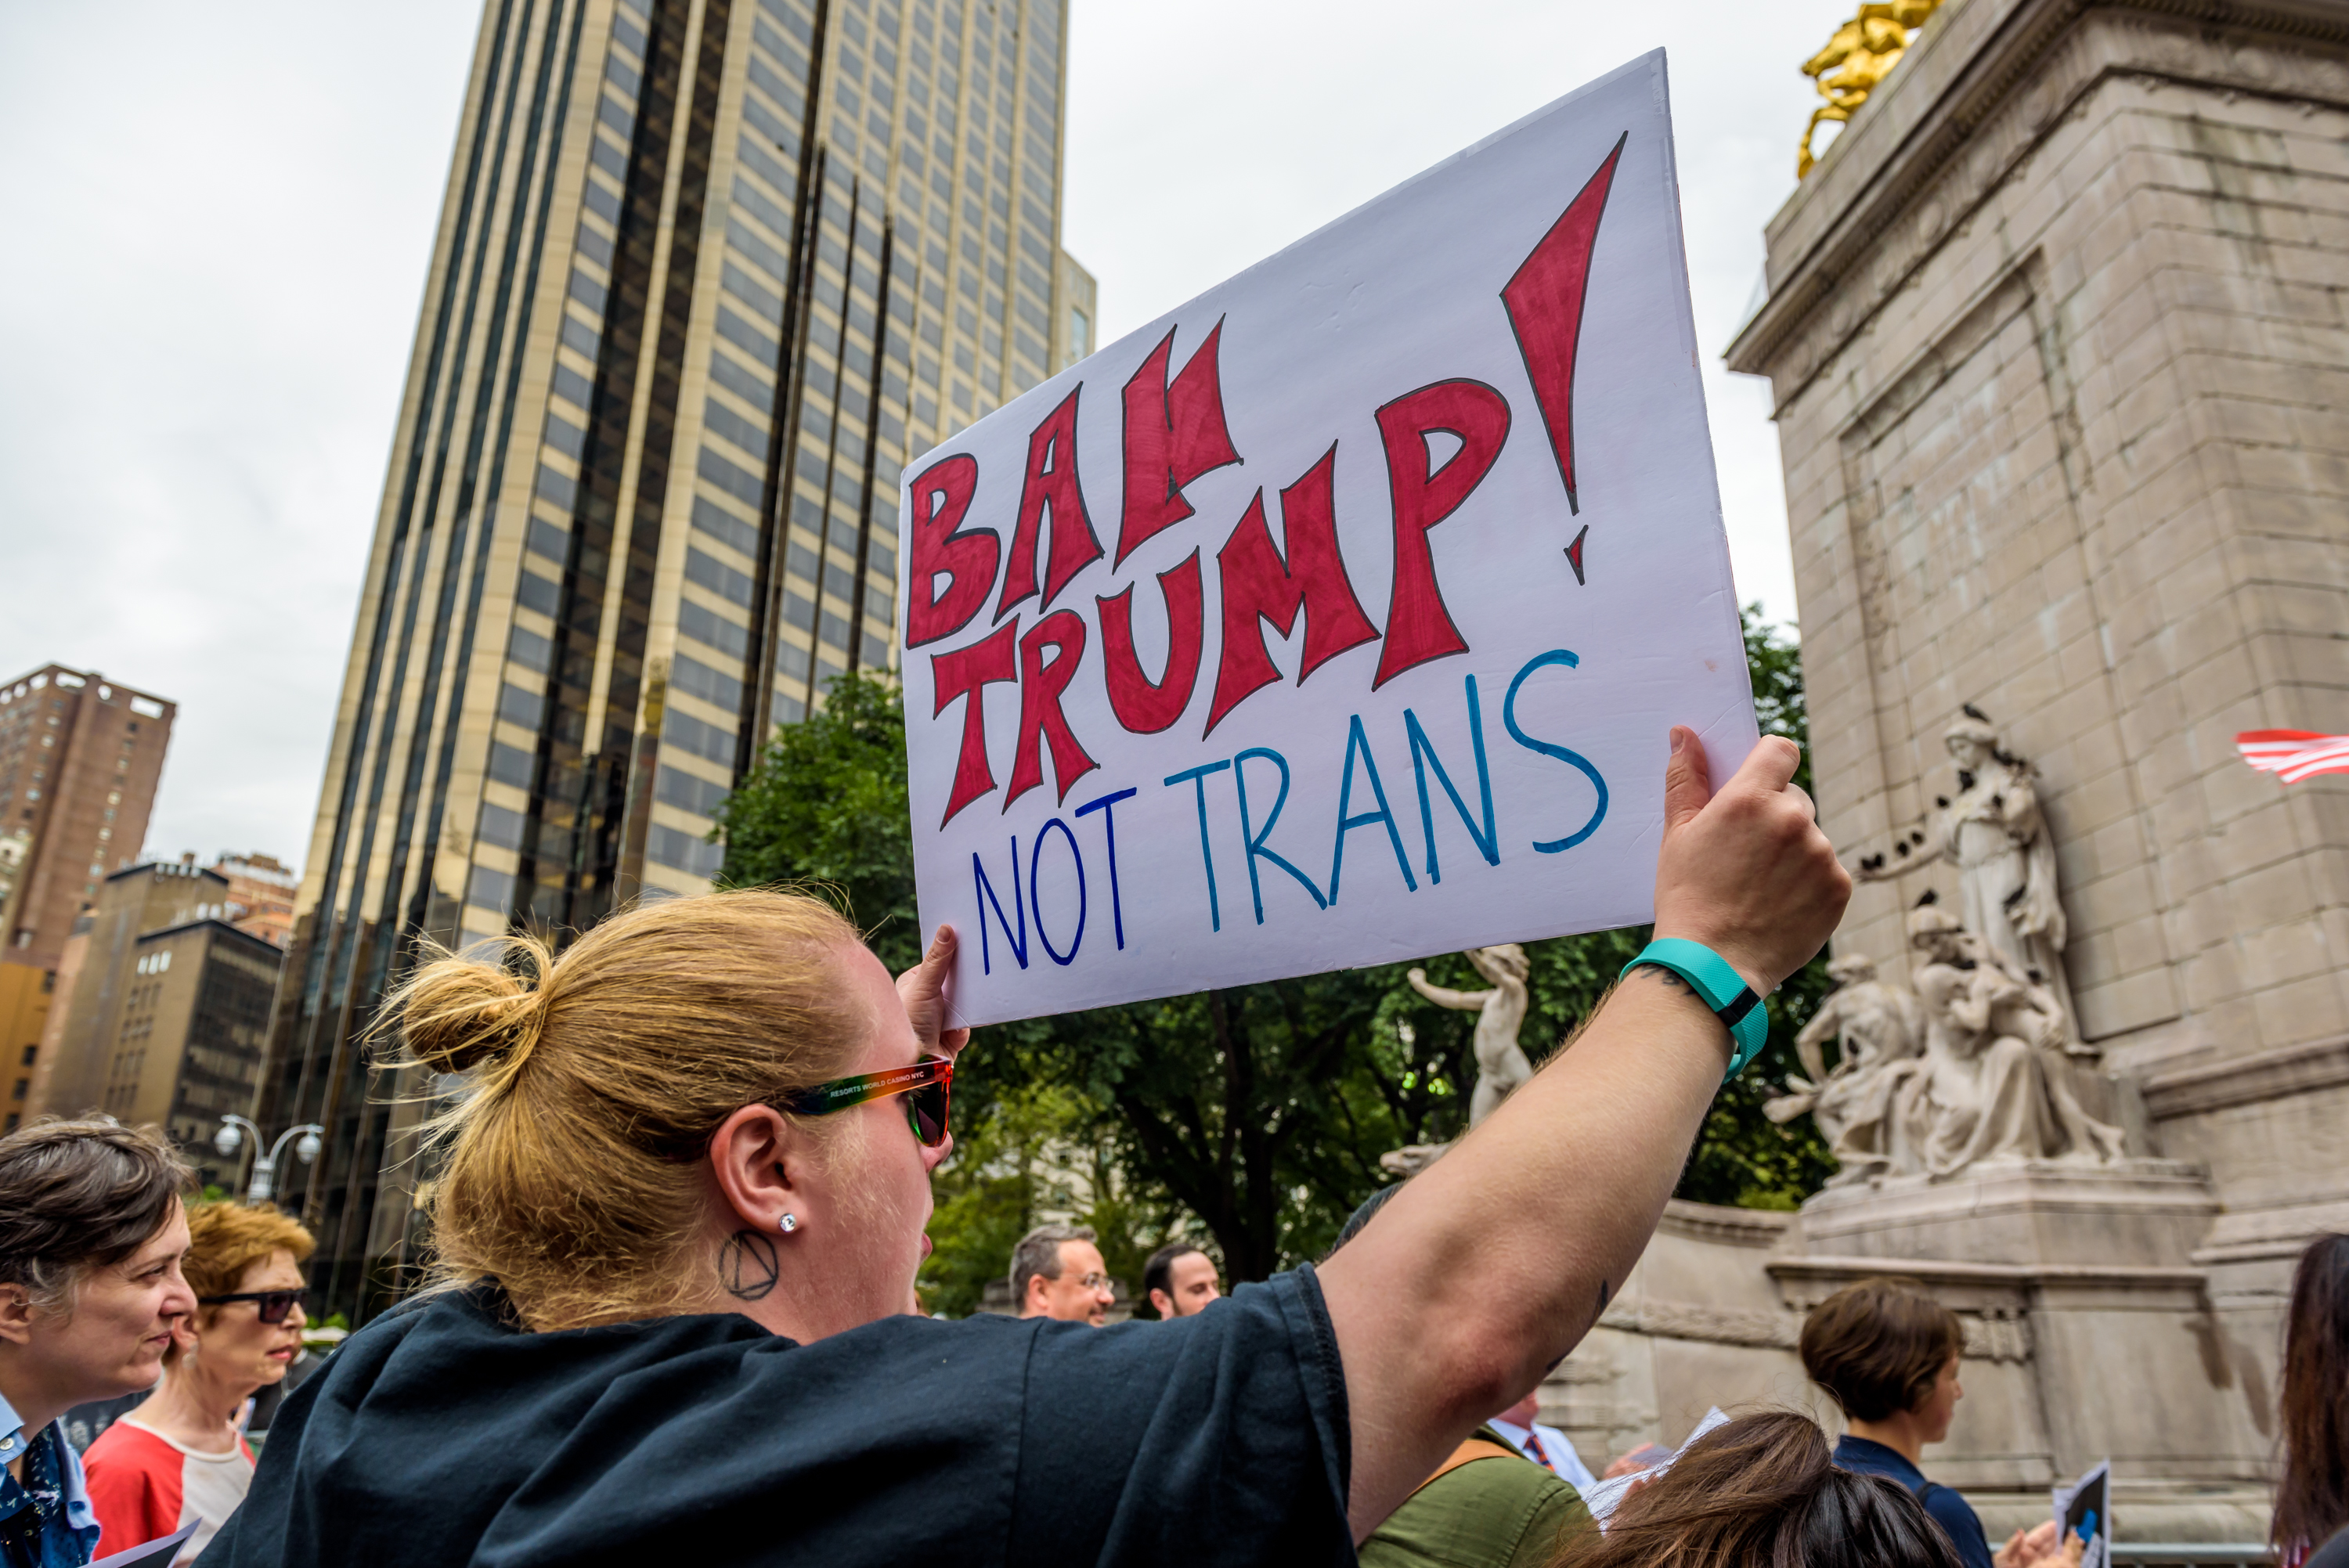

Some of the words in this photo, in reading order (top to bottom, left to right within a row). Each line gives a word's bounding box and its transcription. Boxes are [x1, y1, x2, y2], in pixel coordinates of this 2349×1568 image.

[930, 130, 1629, 832] TRUMP!
[972, 787, 1137, 975] NOT
[1164, 649, 1608, 932] TRANS
[830, 1086, 861, 1098] RESORTS
[862, 1080, 886, 1090] WORLD
[886, 1074, 911, 1085] CASINO
[911, 1071, 924, 1080] NYC
